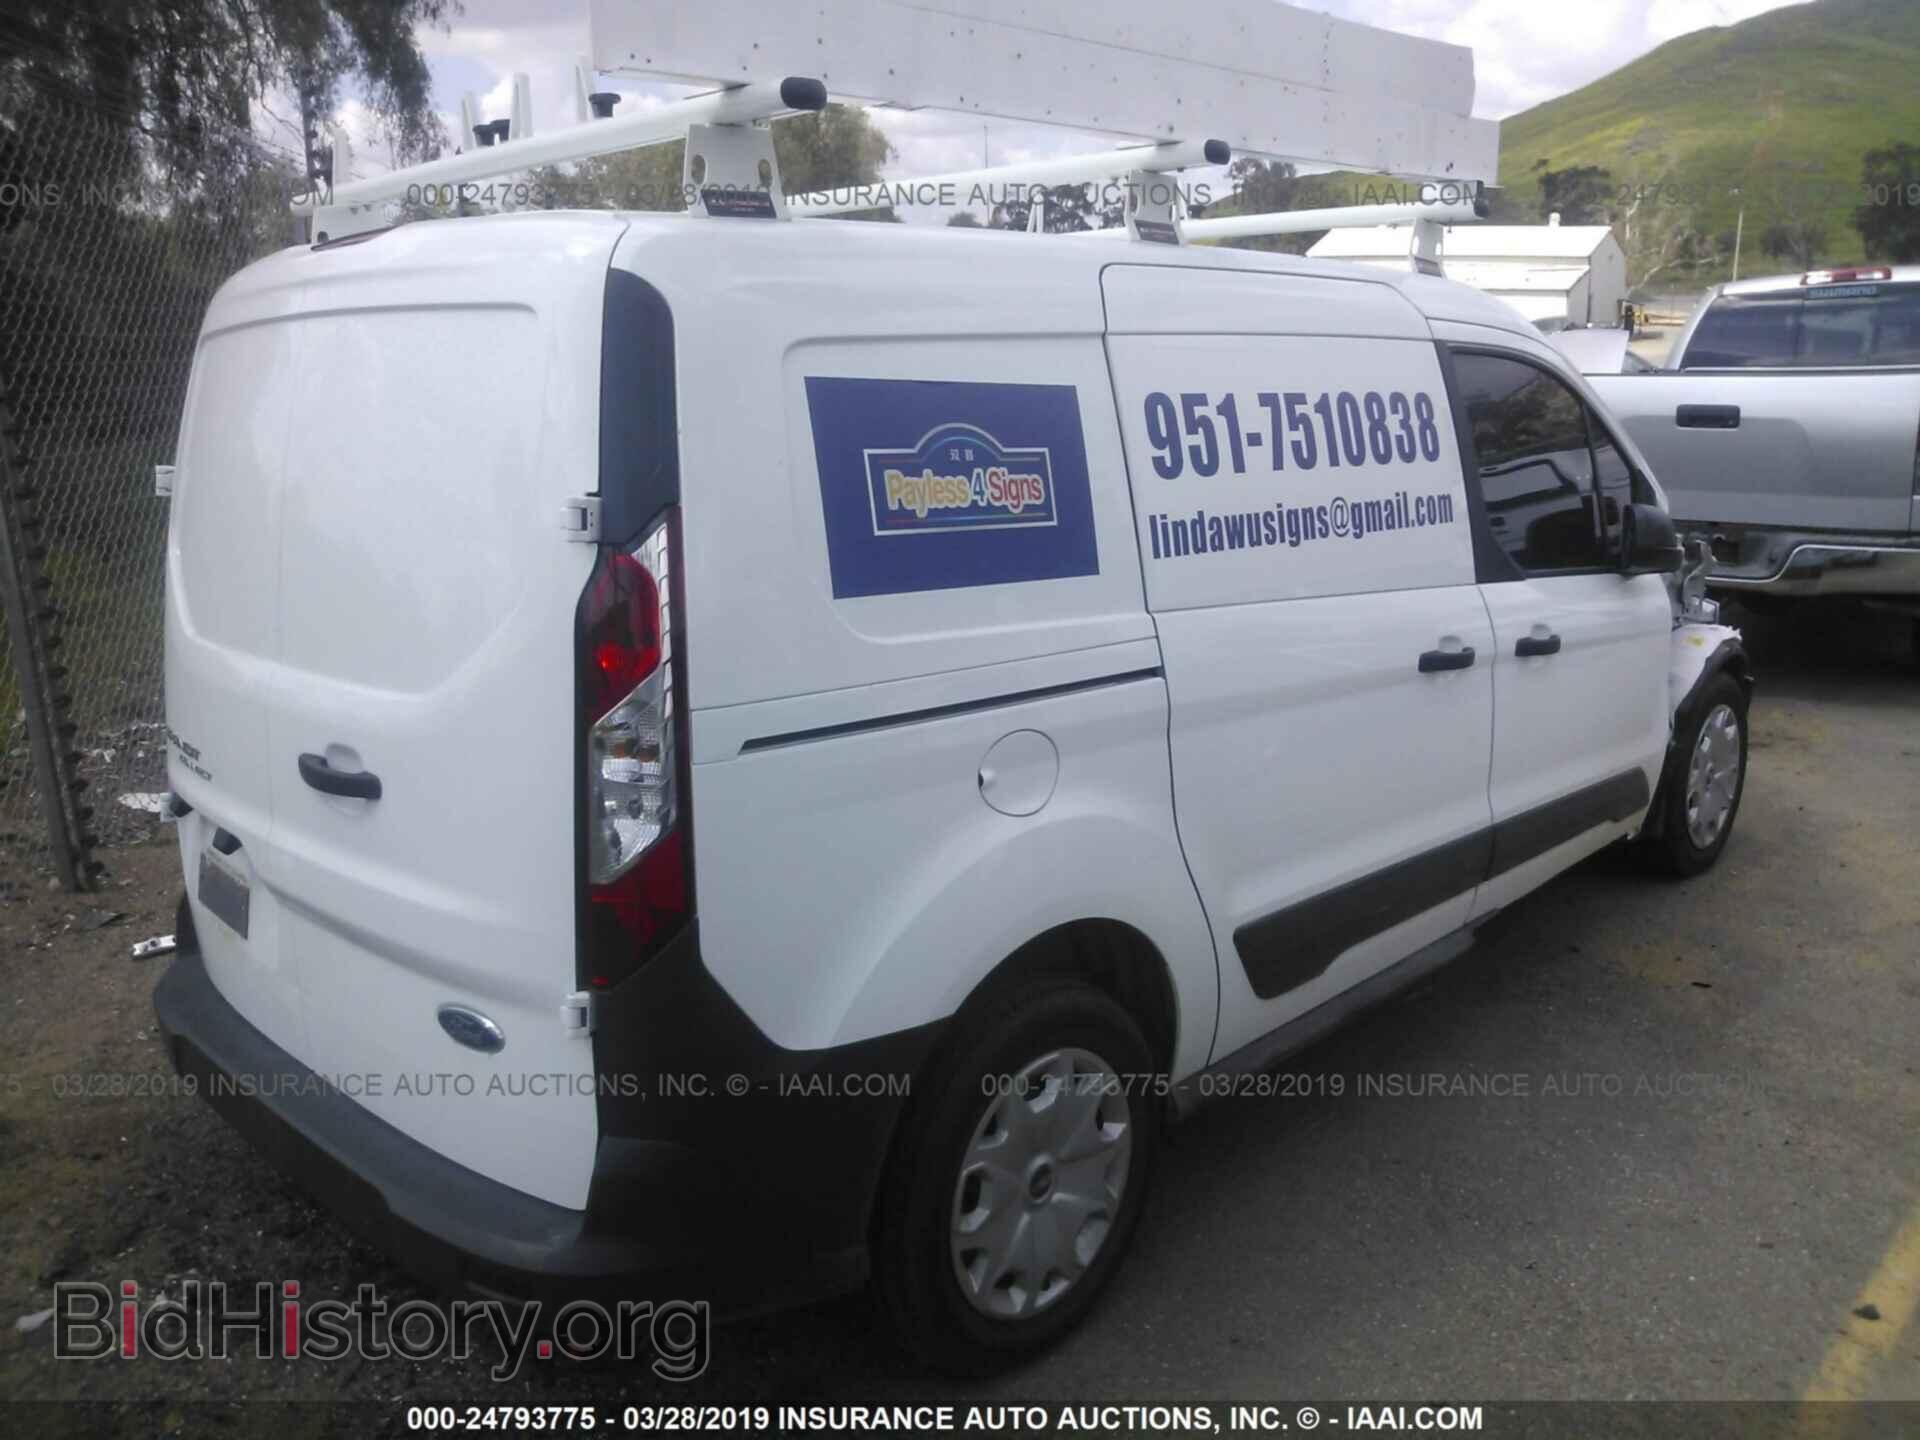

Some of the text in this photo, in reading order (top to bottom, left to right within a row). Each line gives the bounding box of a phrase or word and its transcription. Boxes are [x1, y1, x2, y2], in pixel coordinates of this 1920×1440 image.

[1144, 391, 1440, 480] 951-7510838
[884, 468, 971, 519] Payless
[986, 467, 1045, 514] Signs
[1149, 491, 1454, 559] lindawusigns@gmail.com
